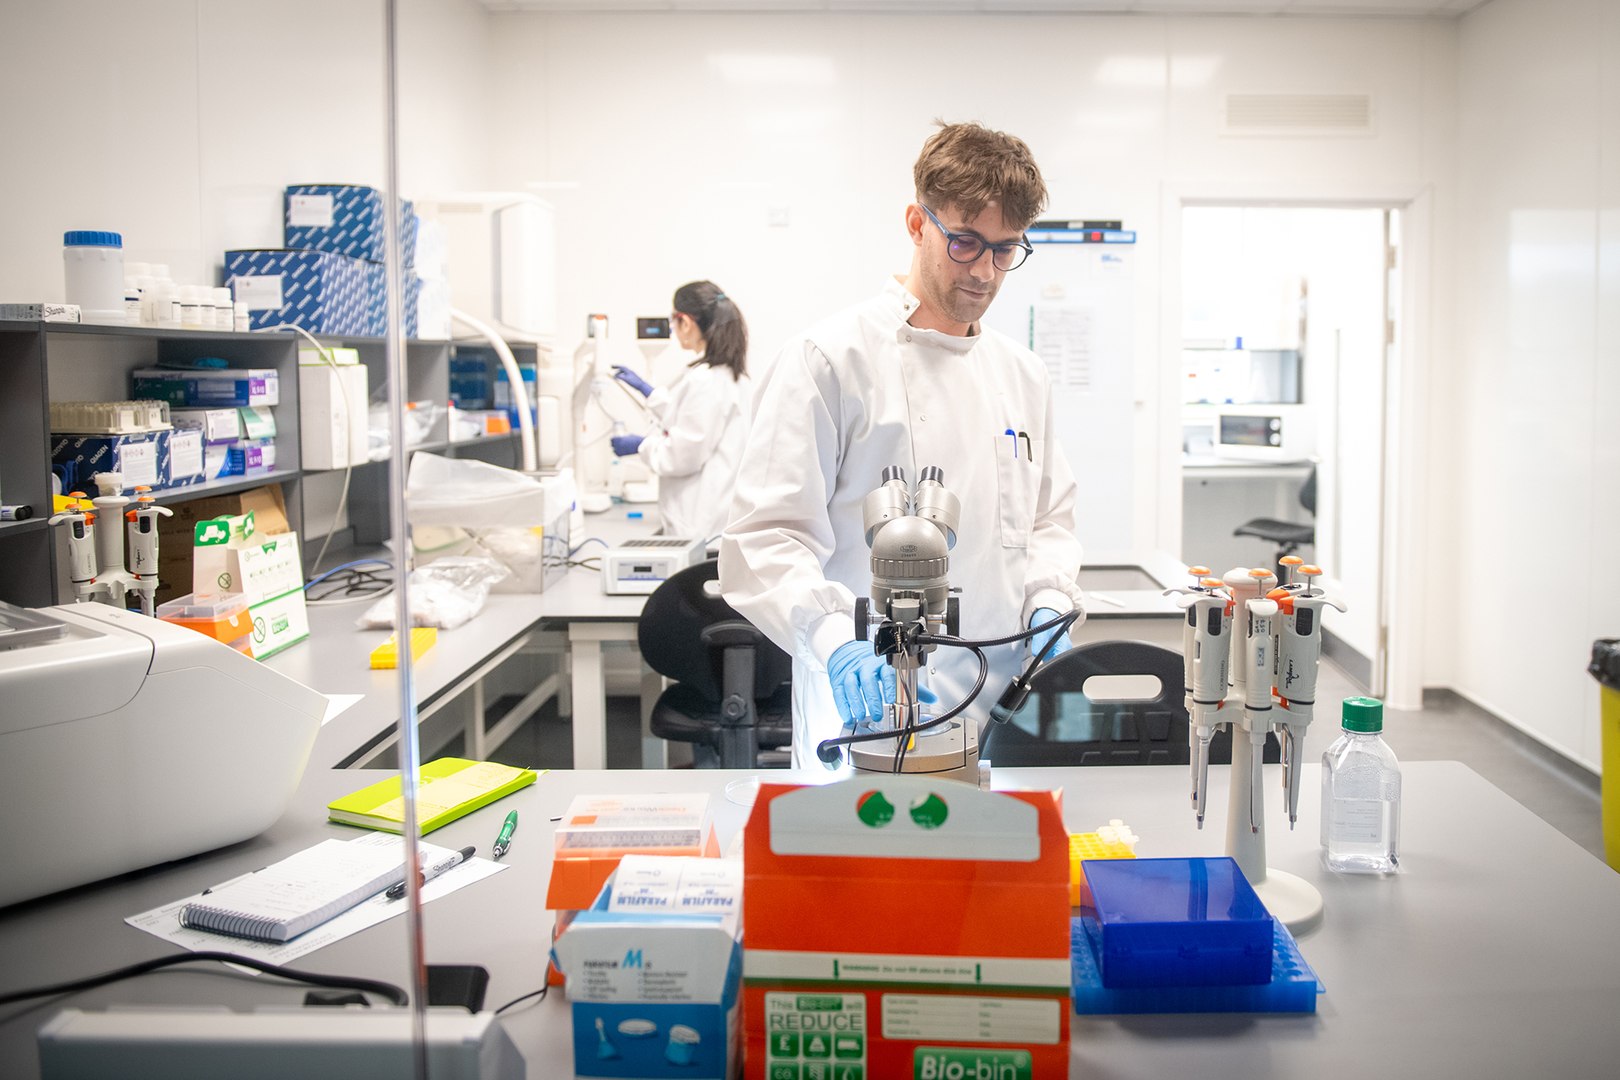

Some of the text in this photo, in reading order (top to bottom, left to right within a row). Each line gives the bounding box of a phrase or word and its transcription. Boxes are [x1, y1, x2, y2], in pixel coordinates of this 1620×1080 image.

[89, 444, 109, 465] QIAGEN
[617, 896, 668, 906] PARAFILM
[682, 897, 734, 907] PARAFILM
[622, 949, 643, 969] M
[770, 1000, 793, 1009] This
[770, 1012, 863, 1030] REDUCE
